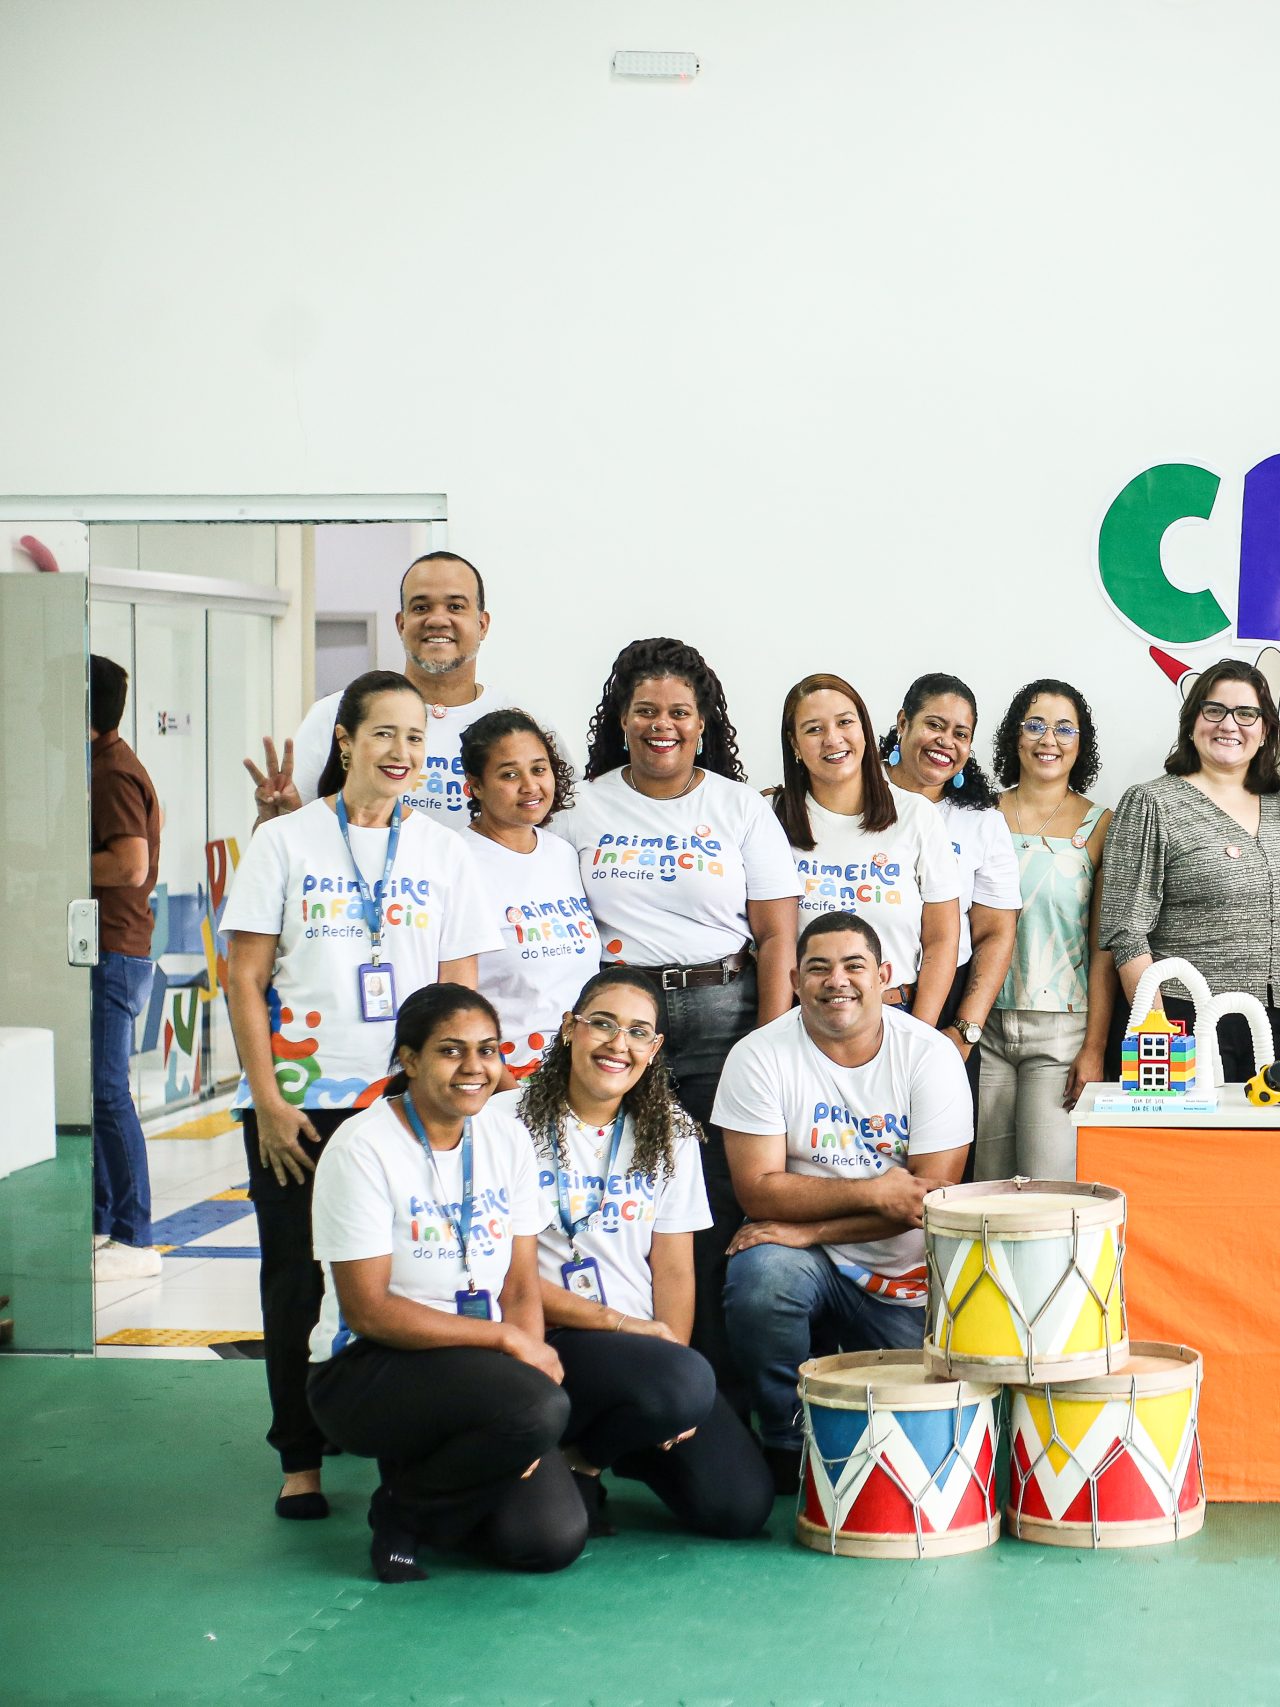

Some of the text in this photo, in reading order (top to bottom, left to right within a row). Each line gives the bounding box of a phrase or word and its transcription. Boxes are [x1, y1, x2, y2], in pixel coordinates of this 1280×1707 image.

[402, 794, 442, 810] Recife
[591, 867, 654, 880] do Recife
[797, 859, 901, 886] RimEiRa
[804, 877, 902, 905] Fância
[797, 899, 836, 912] Recife
[322, 925, 364, 939] Recife
[515, 917, 597, 944] InFânci
[521, 943, 572, 960] do Recife
[811, 1153, 871, 1167] do Recife
[413, 1246, 433, 1259] do
